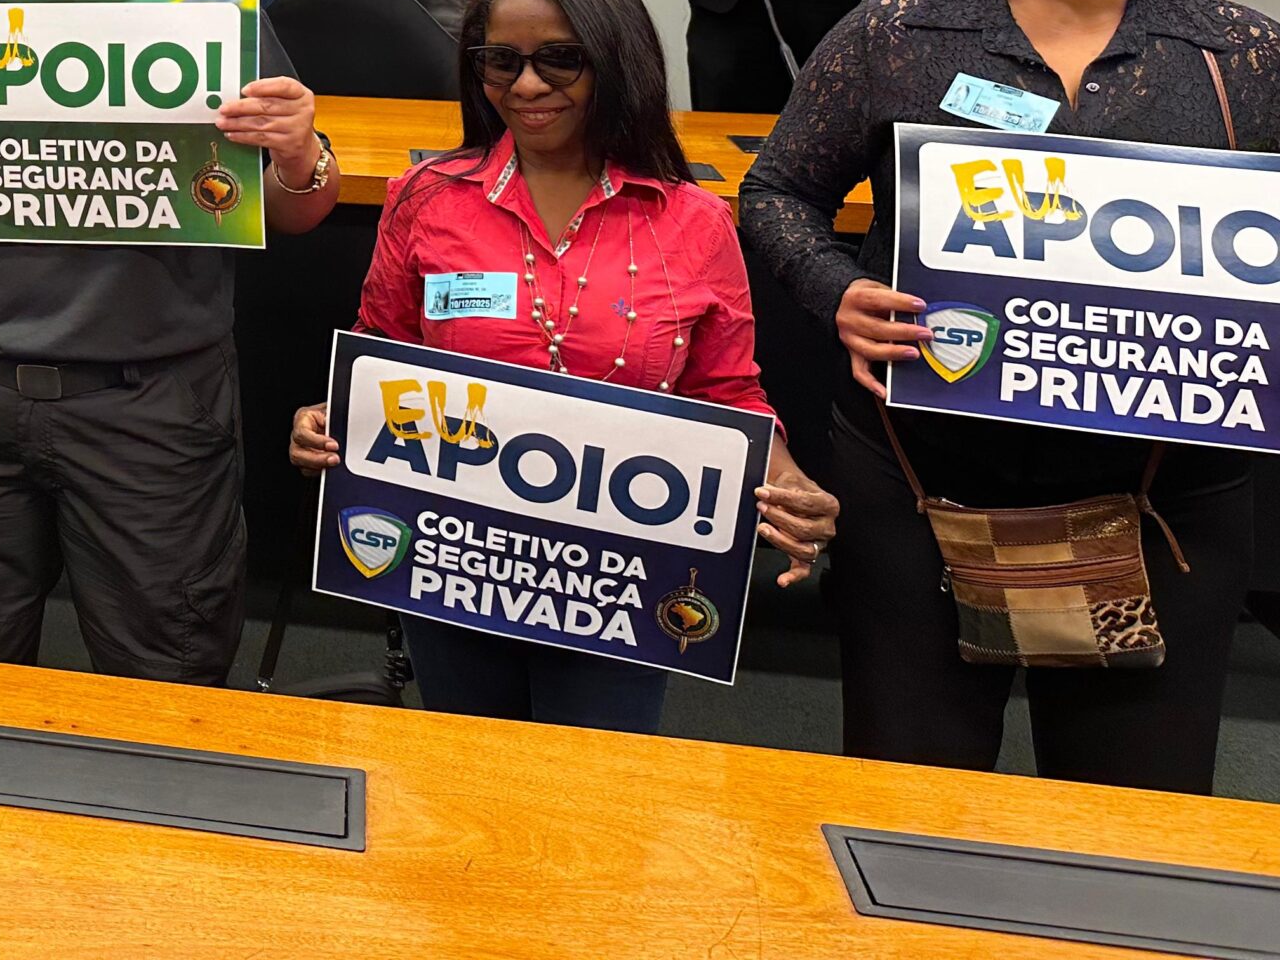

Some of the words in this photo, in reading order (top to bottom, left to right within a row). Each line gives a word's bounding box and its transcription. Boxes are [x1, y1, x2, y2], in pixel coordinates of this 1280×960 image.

[136, 141, 177, 162] DA
[950, 157, 1083, 222] EU
[1004, 297, 1202, 342] COLETIVO
[1215, 320, 1270, 350] DA
[1002, 329, 1269, 388] SEGURANÇA
[379, 379, 493, 448] EU
[1000, 361, 1266, 432] PRIVADA
[365, 406, 722, 536] APOIO!
[350, 527, 397, 550] CSP
[416, 511, 589, 567] COLETIVO
[600, 550, 647, 580] DA
[409, 566, 638, 647] PRIVADA
[414, 539, 643, 609] SEGURANÇA
